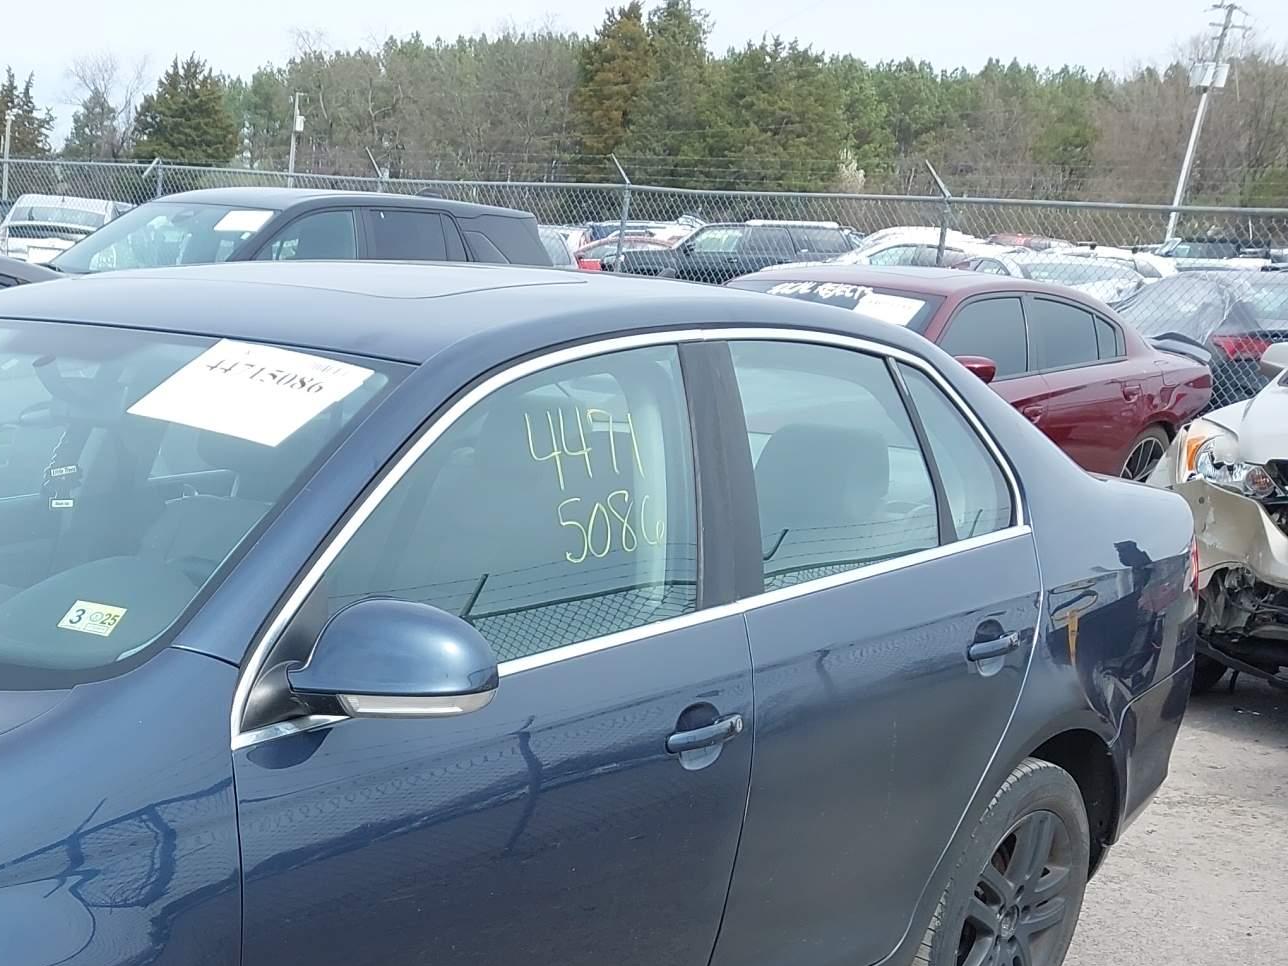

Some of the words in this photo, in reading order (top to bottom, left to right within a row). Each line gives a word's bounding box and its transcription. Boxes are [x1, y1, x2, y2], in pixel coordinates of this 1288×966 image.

[524, 407, 646, 490] 4471
[558, 489, 665, 563] 5086
[68, 608, 86, 625] 3
[99, 612, 121, 627] 25
